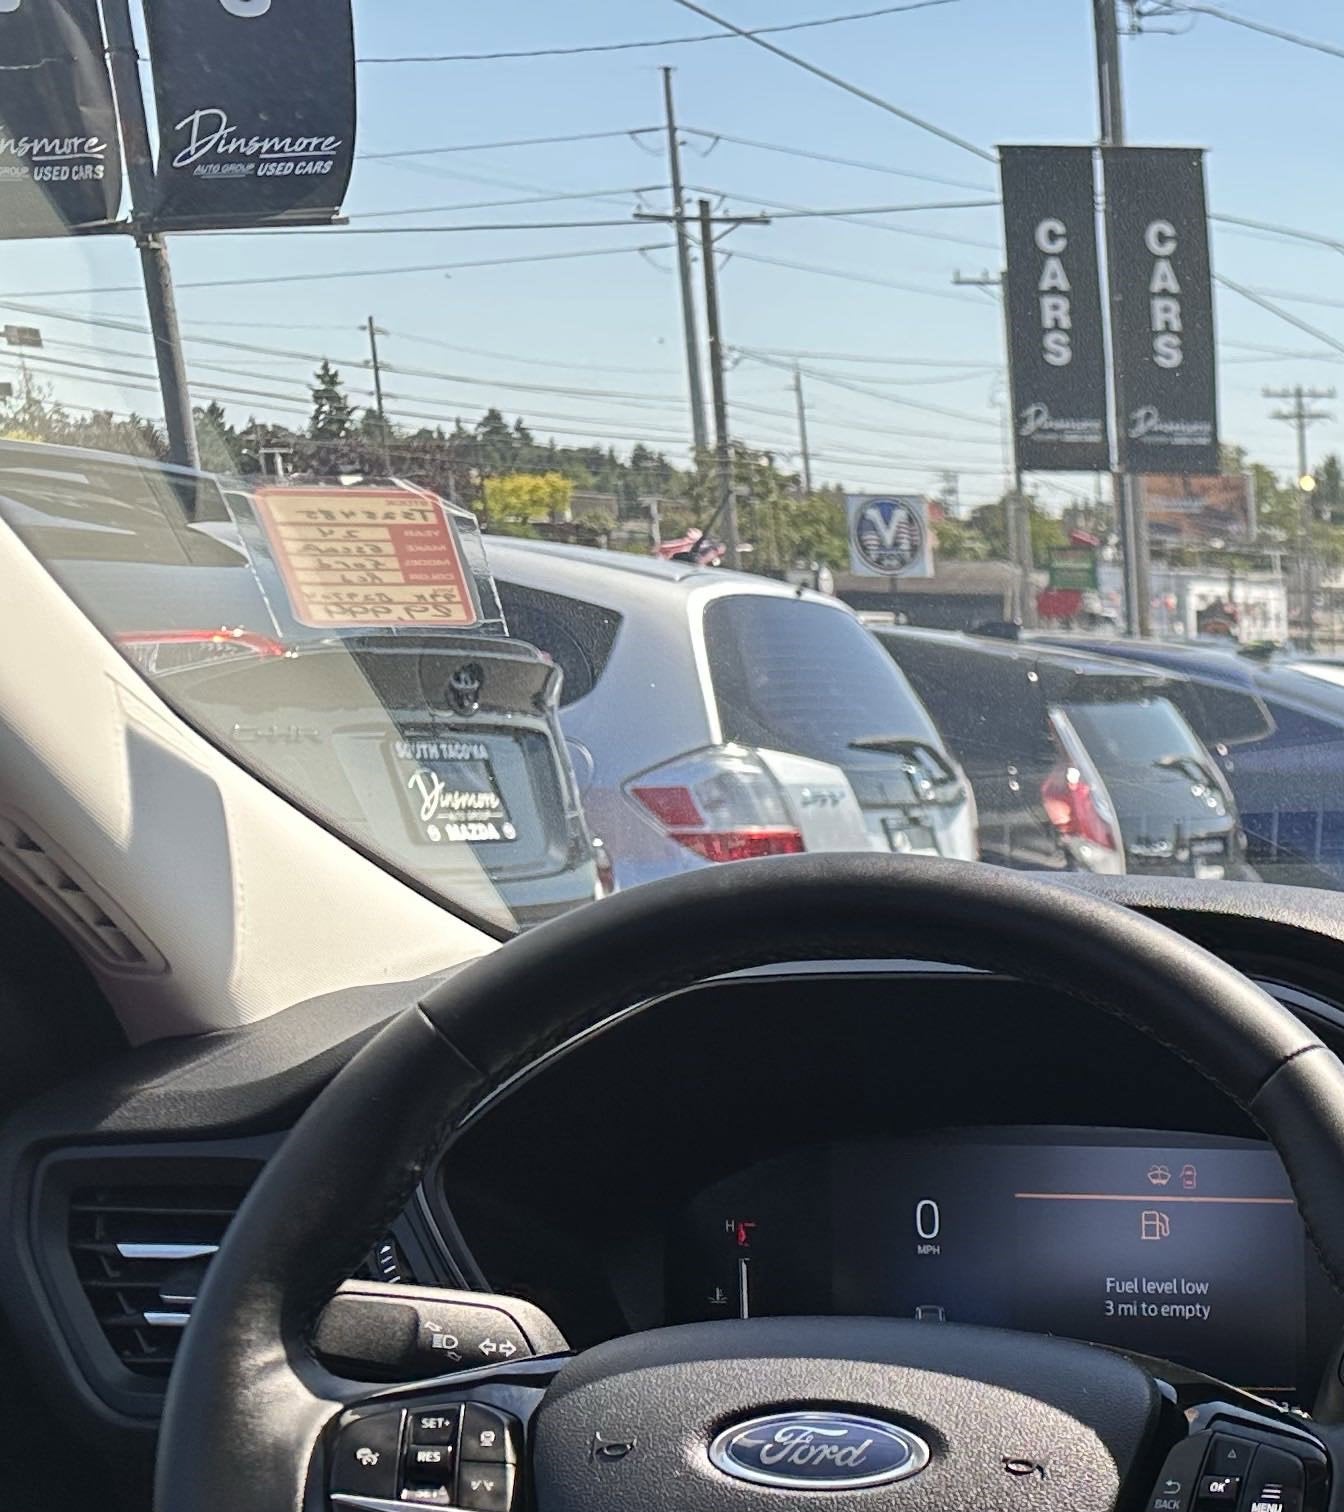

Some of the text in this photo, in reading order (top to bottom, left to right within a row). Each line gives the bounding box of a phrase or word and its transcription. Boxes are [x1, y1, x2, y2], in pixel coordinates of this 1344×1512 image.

[0, 136, 108, 157] nsmore
[173, 108, 342, 168] Dinsmore
[33, 165, 69, 181] USED
[71, 164, 105, 181] CARS
[194, 160, 333, 177] AUTO GROUP USED CARS
[1034, 217, 1072, 367] CARS
[1145, 219, 1183, 369] CARS
[445, 823, 500, 841] MAZDA
[915, 1200, 939, 1239] 0
[917, 1244, 940, 1255] MPH
[1106, 1276, 1209, 1296] Fuel level low
[1105, 1300, 1211, 1321] 3 mi to empty
[421, 1417, 451, 1430] SET+
[417, 1450, 440, 1463] RES
[758, 1425, 872, 1469] Ford
[1209, 1481, 1226, 1494] OK
[1154, 1499, 1180, 1511] BACK
